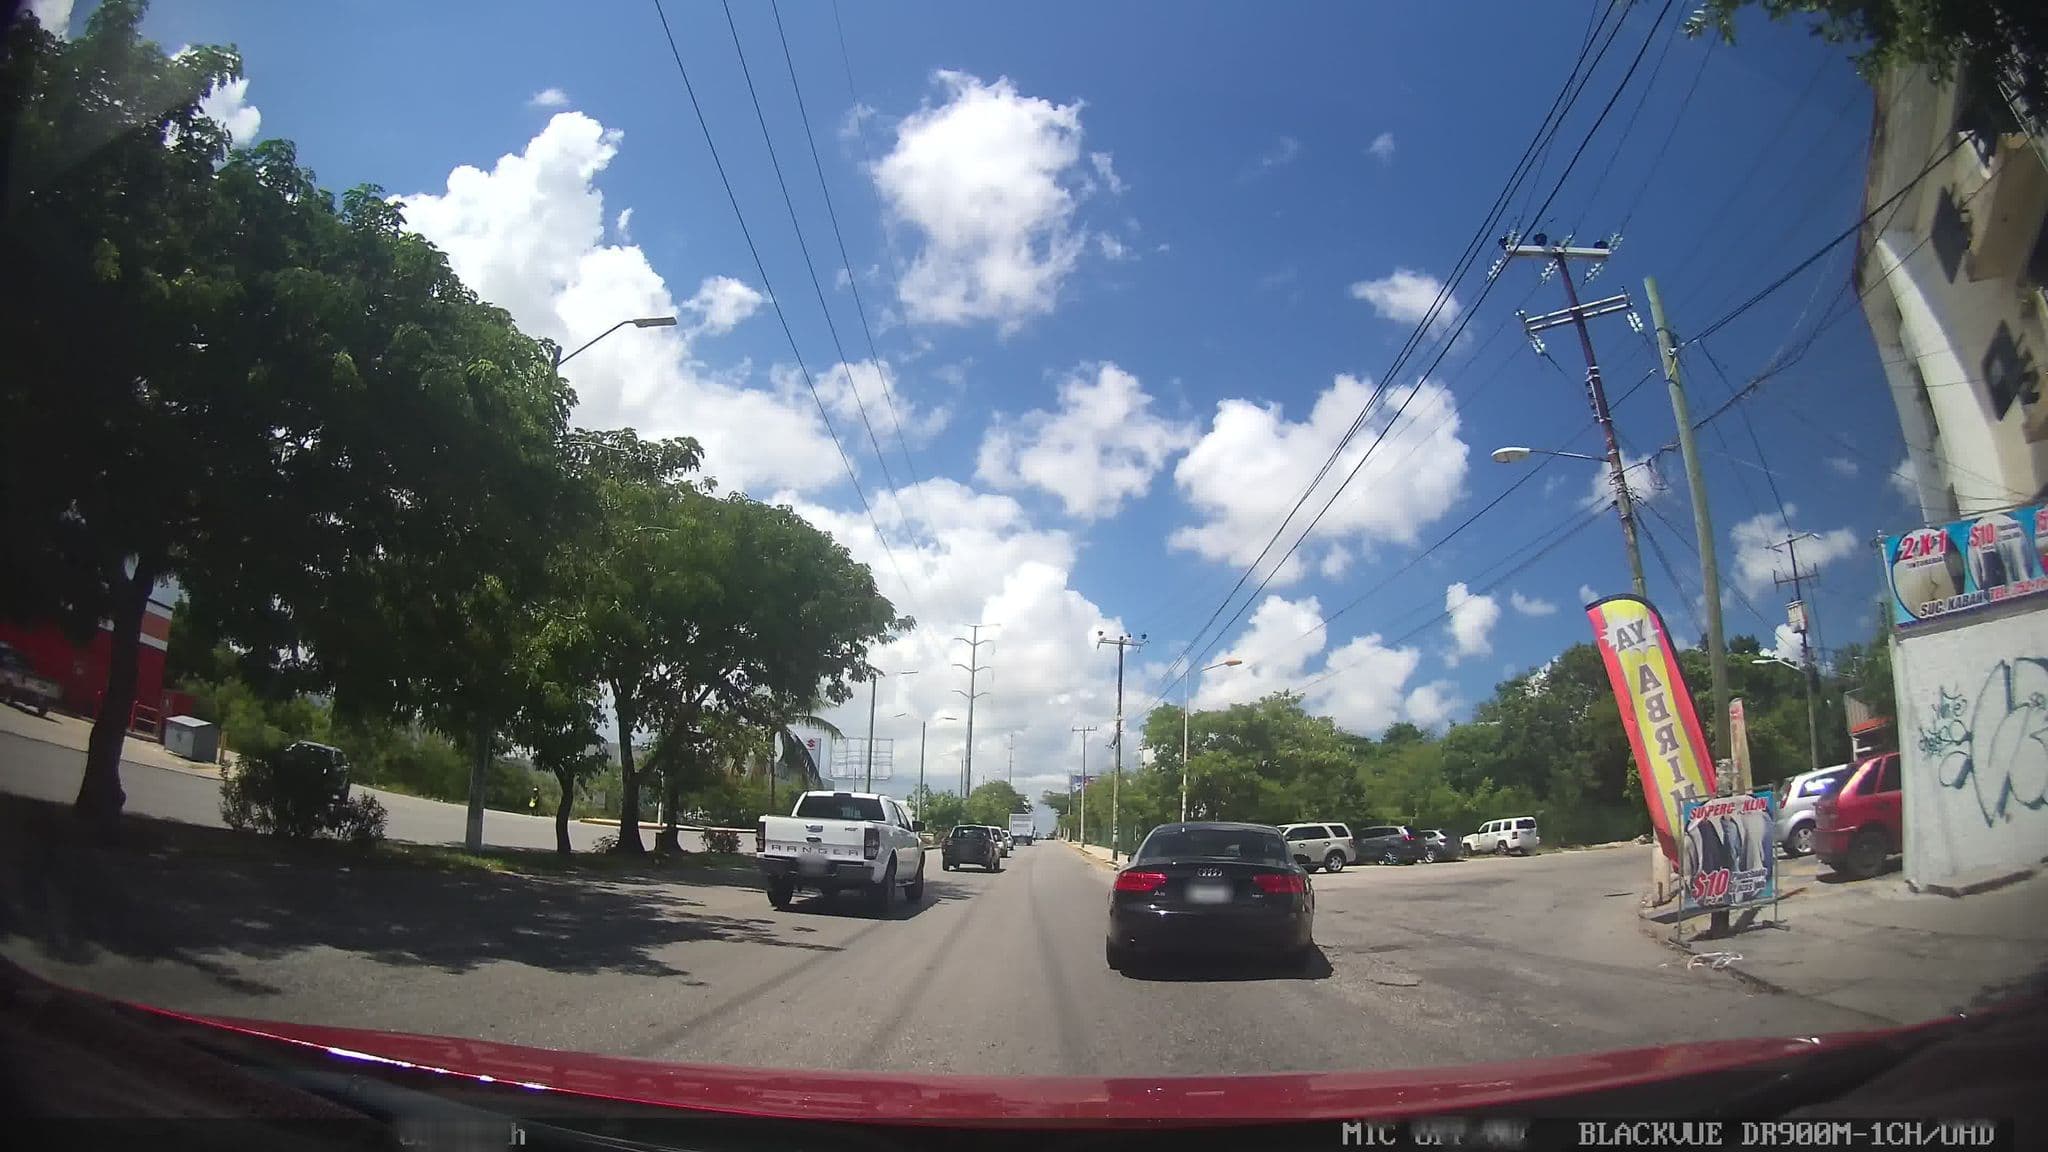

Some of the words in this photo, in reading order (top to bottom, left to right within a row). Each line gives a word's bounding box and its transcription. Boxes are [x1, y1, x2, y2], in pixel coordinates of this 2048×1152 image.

[1920, 601, 1946, 617] SUC.
[771, 844, 859, 857] RANGER
[1692, 868, 1729, 899] $10
